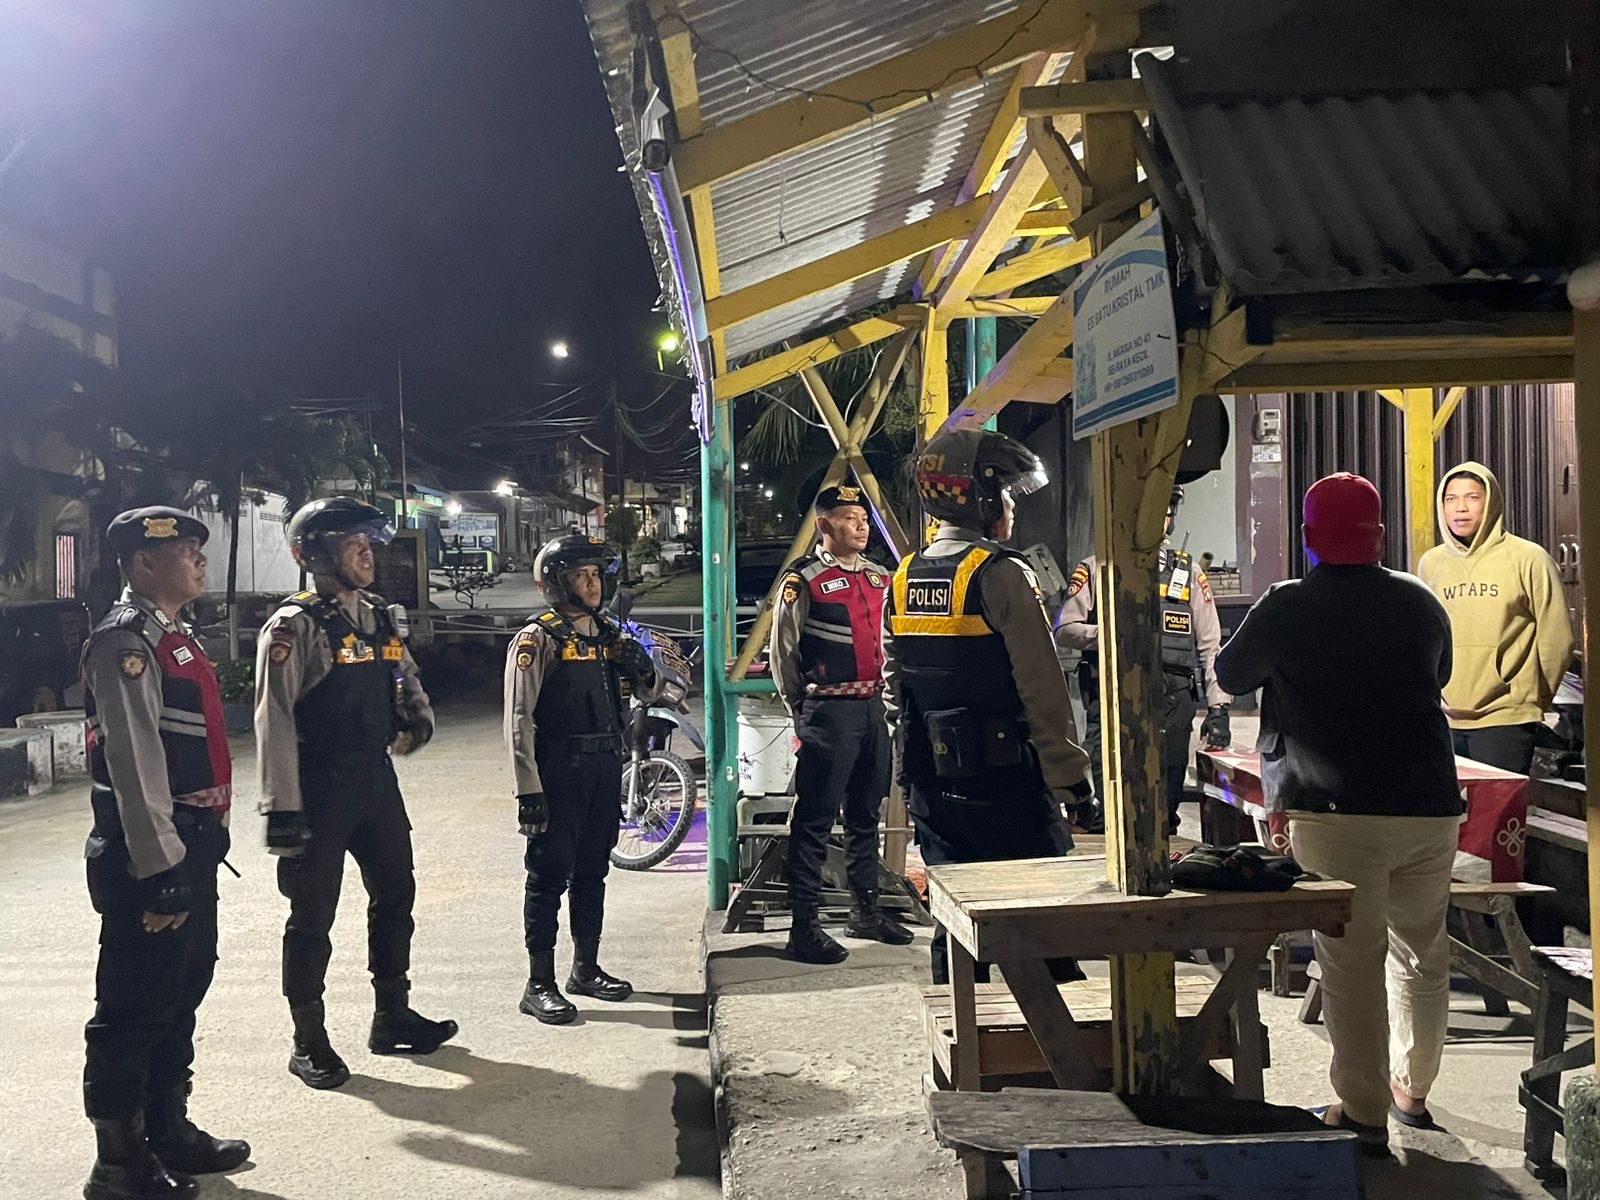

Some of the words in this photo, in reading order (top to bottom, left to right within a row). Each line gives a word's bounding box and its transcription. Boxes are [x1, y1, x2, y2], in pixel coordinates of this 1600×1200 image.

[1104, 264, 1131, 295] RUMAH
[1087, 315, 1094, 332] ES
[1094, 304, 1112, 326] BATU
[1112, 283, 1144, 314] KRISTAL
[1145, 270, 1165, 293] TMK
[1133, 335, 1143, 348] NO
[1132, 349, 1149, 364] KECIL
[909, 588, 948, 606] POLISI
[1443, 582, 1499, 600] WTAPS
[1166, 615, 1189, 625] POLISI
